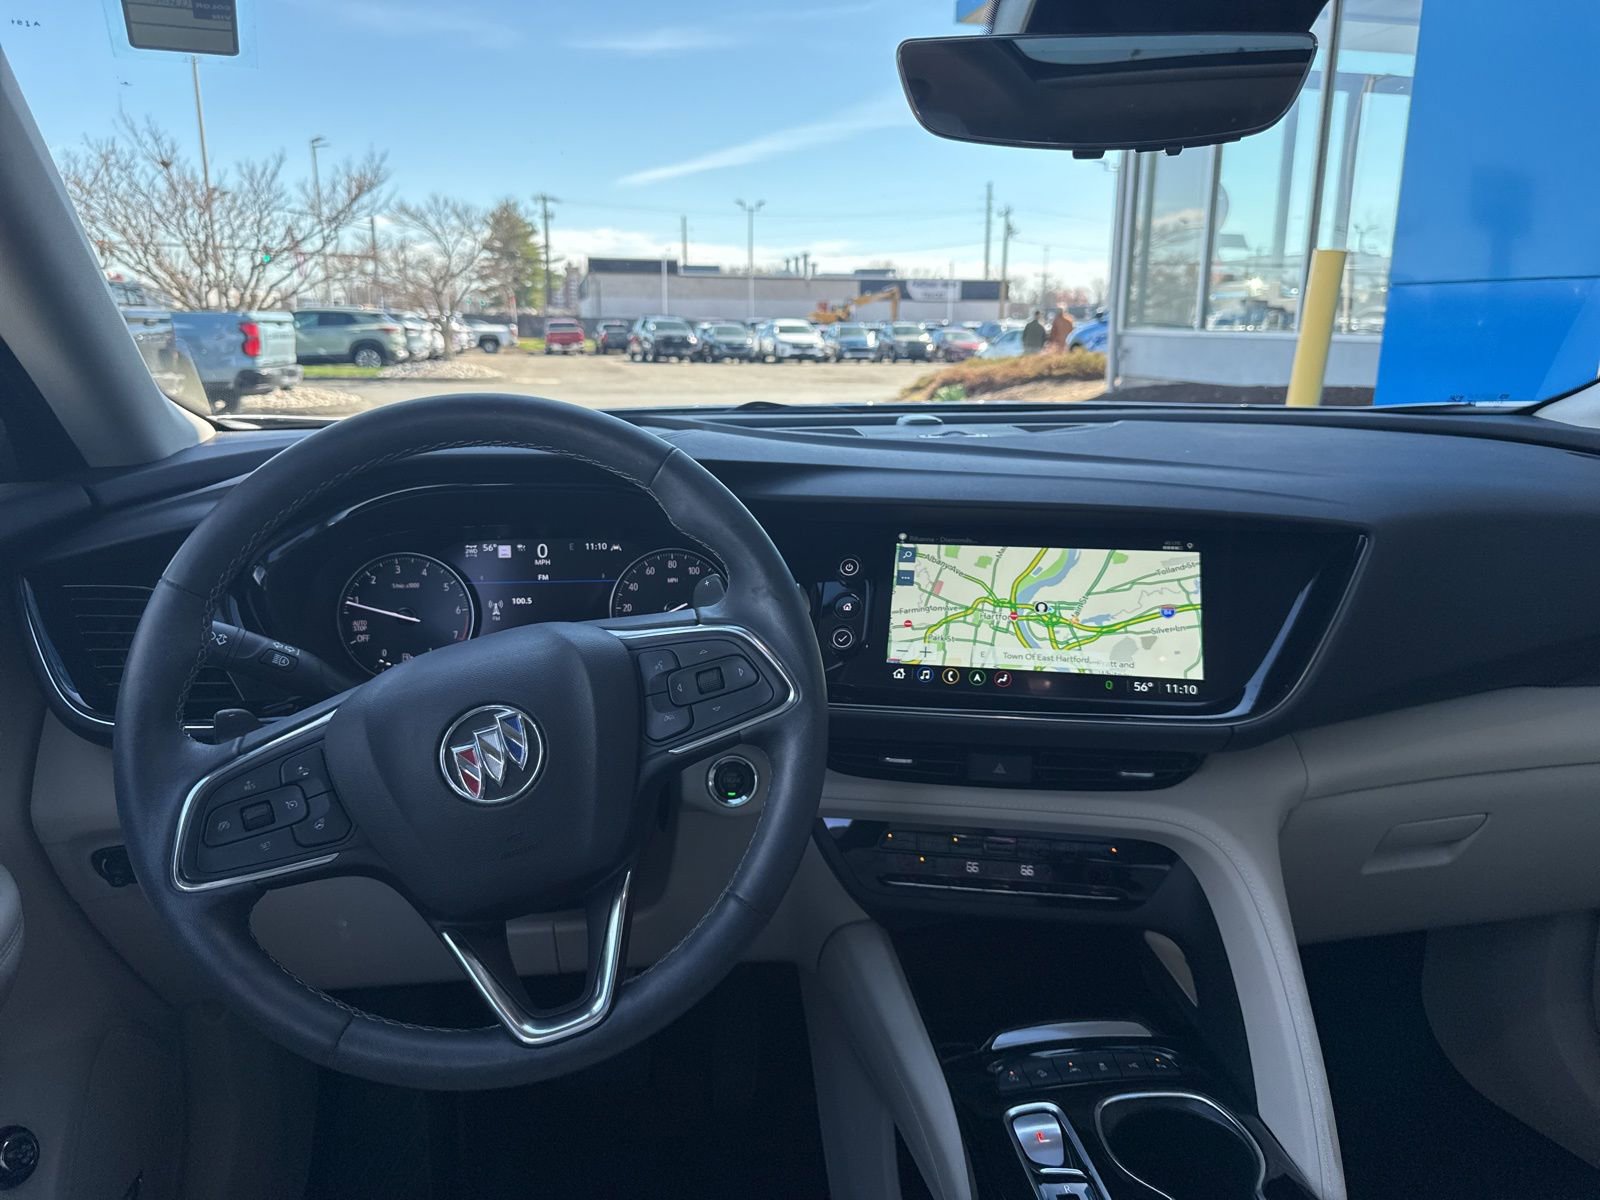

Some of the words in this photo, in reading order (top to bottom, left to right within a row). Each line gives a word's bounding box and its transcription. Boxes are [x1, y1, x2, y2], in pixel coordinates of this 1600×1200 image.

[482, 543, 497, 552] 56°
[536, 543, 548, 559] 0
[585, 543, 607, 551] 11:10
[667, 560, 677, 568] 80
[395, 565, 401, 574] 3
[421, 568, 427, 576] 4
[645, 567, 655, 575] 60
[688, 567, 700, 575] 100
[1156, 564, 1186, 576] Tolland
[370, 575, 377, 584] 2
[443, 582, 450, 592] 5
[628, 582, 638, 591] 40
[455, 606, 461, 614] 6
[623, 604, 632, 612] 20
[899, 605, 942, 615] Farmington
[356, 634, 370, 642] OFF
[381, 649, 387, 657] 0
[1003, 652, 1023, 660] Town
[1134, 681, 1154, 692] 56°
[1165, 683, 1198, 695] 11:10
[966, 861, 979, 873] 66
[1020, 864, 1034, 876] 66
[1063, 1184, 1072, 1193] R
